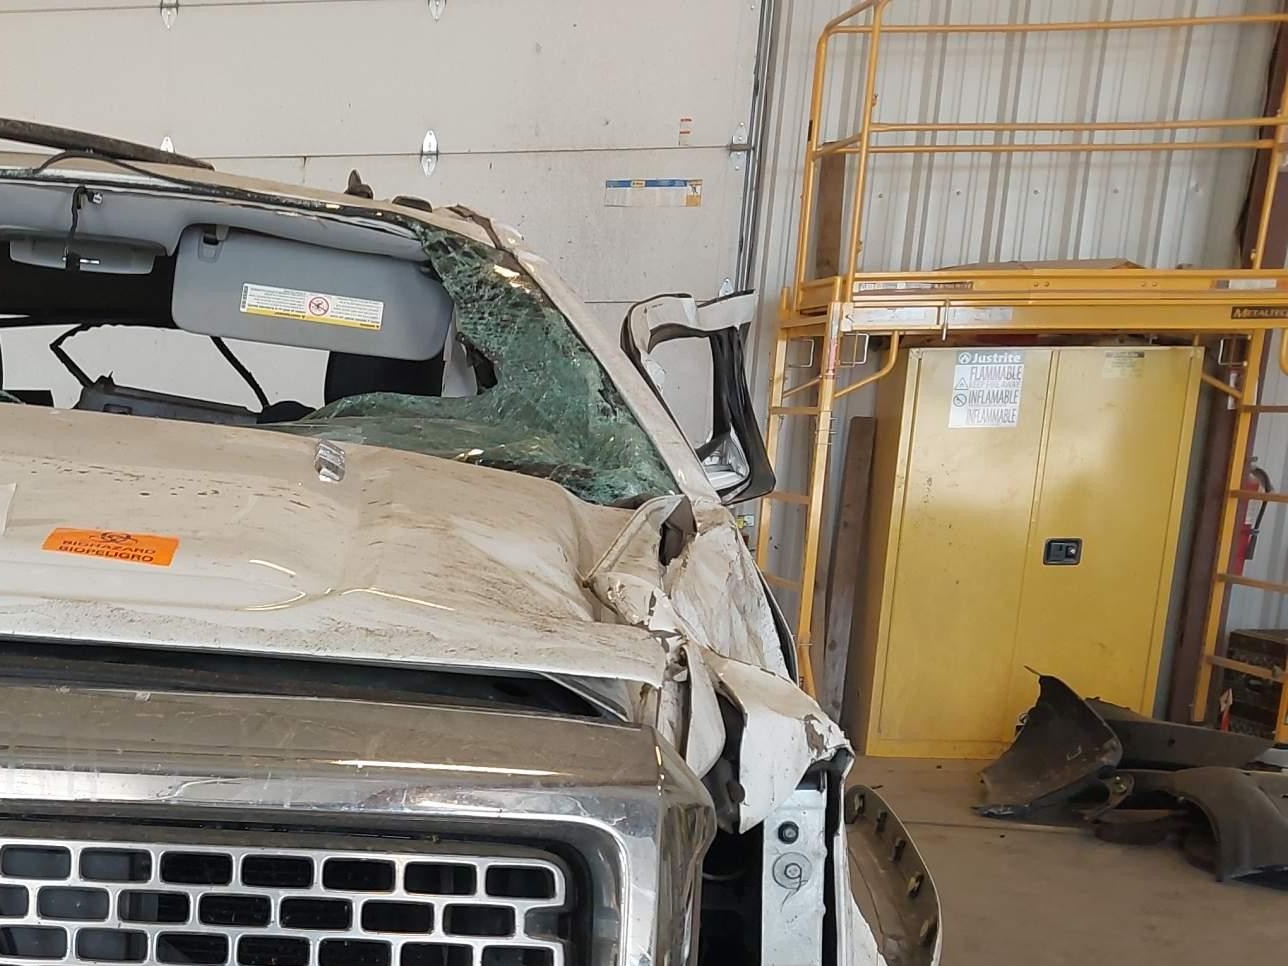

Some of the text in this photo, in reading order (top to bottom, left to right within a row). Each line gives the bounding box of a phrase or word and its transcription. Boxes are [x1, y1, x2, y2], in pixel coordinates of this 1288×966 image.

[971, 352, 1022, 363] Justrite
[970, 365, 1022, 380] FLAMMABLE
[968, 389, 1020, 404] INFLAMABLE
[58, 545, 154, 562] BIOPELIGRO
[63, 540, 156, 554] BIOHAZARD
